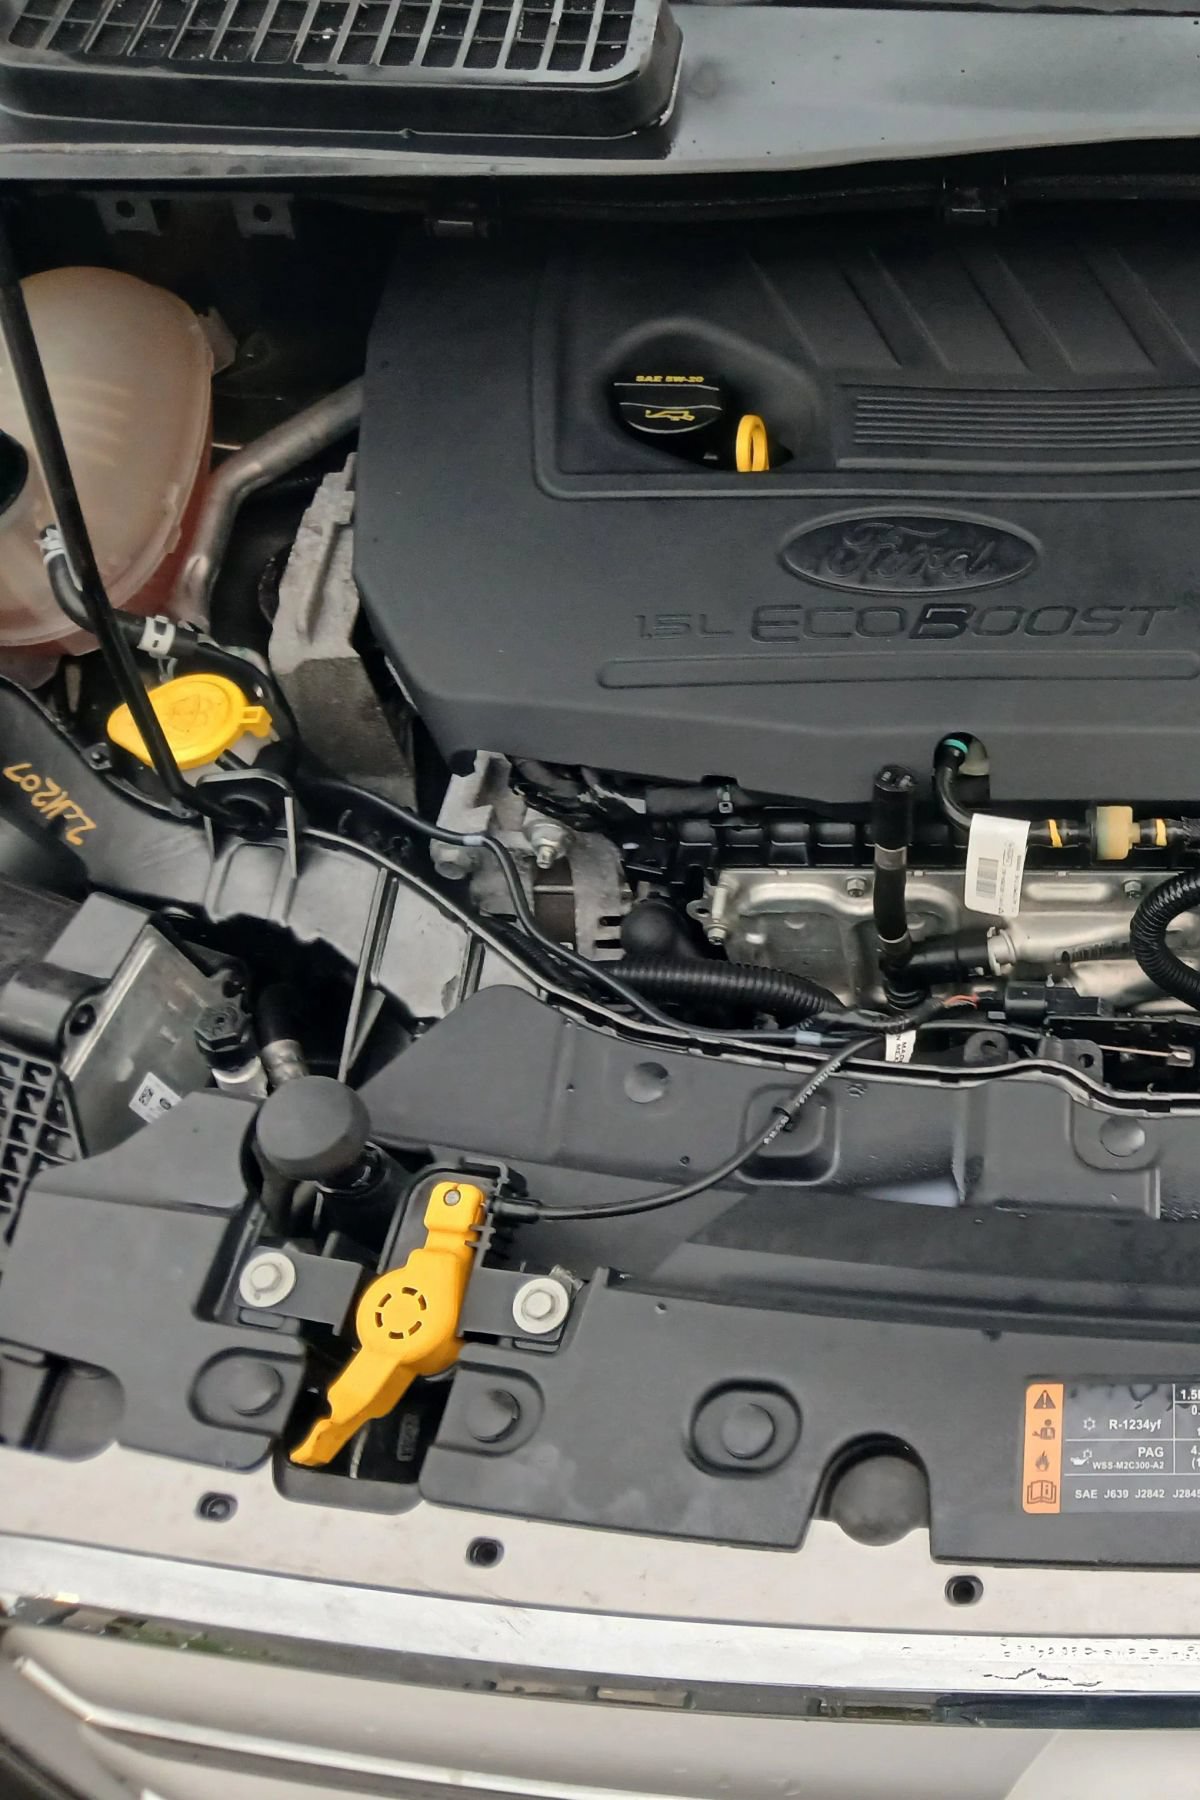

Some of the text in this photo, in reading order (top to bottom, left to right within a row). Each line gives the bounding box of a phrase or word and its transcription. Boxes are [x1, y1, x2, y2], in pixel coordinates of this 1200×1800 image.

[636, 375, 704, 383] SAE 5W-20
[826, 521, 997, 585] Ford
[633, 613, 734, 641] 1.5L
[1109, 1419, 1162, 1432] R-1234yf
[1138, 1446, 1164, 1458] PAG
[1074, 1489, 1098, 1499] SAE
[1104, 1489, 1129, 1499] J639
[1135, 1489, 1165, 1499] J2842
